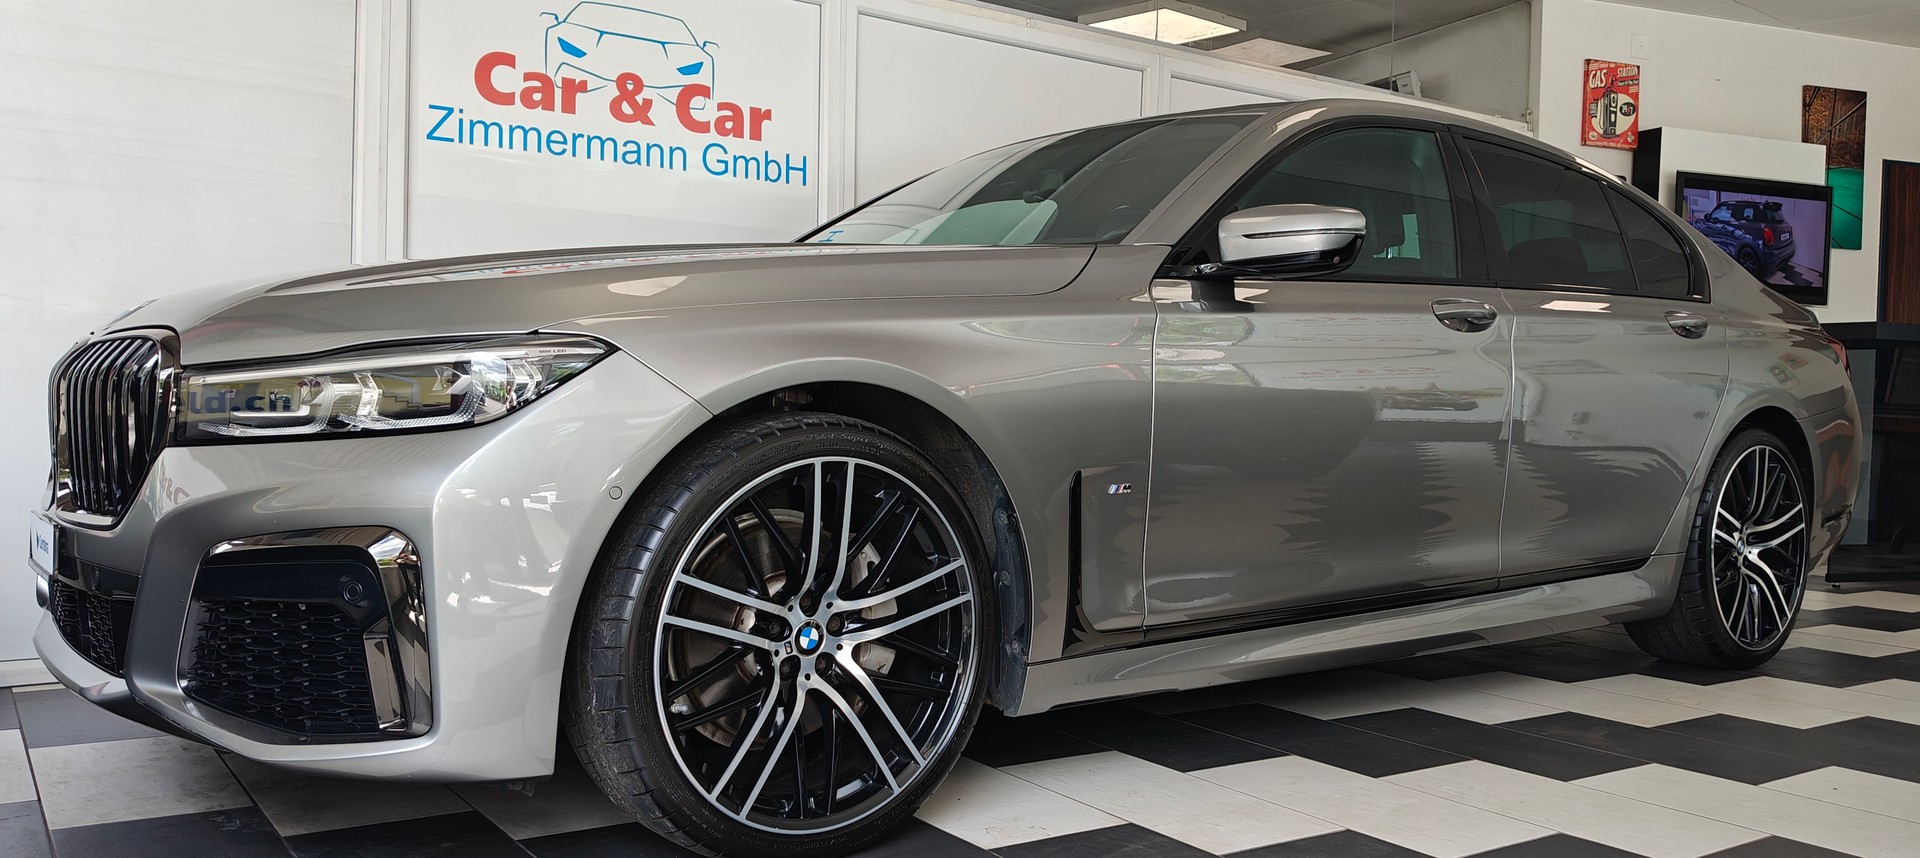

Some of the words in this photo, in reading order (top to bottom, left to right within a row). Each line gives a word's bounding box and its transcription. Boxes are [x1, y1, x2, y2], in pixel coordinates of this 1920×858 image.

[473, 51, 589, 115] Car
[608, 71, 656, 126] &
[675, 83, 773, 142] Car
[1589, 69, 1607, 88] GAS
[1617, 66, 1639, 78] STATION
[426, 104, 688, 172] Zimmermann
[701, 142, 808, 187] GmbH
